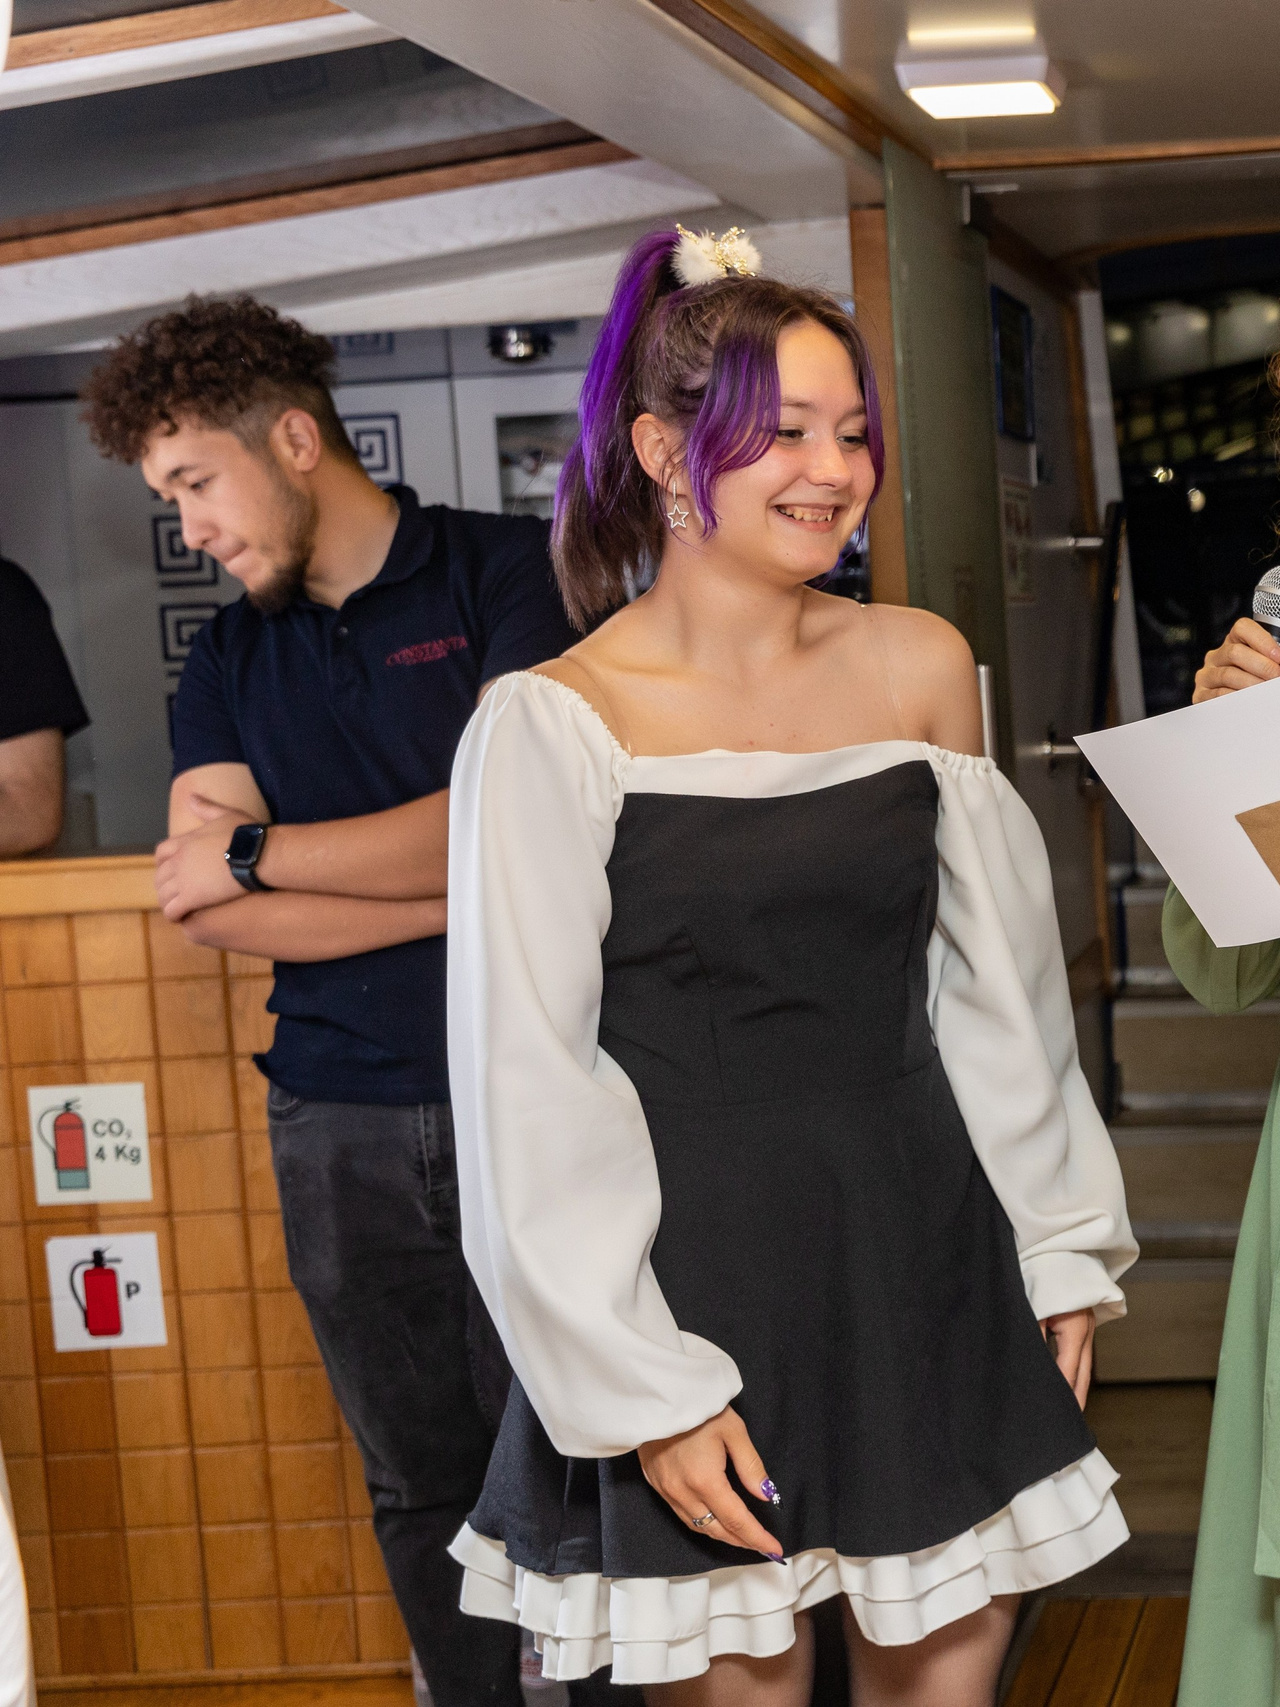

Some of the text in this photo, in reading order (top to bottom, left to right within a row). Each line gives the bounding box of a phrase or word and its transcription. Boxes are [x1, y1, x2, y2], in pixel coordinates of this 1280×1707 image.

[95, 1143, 141, 1165] 4 Kg
[126, 1281, 140, 1299] P
